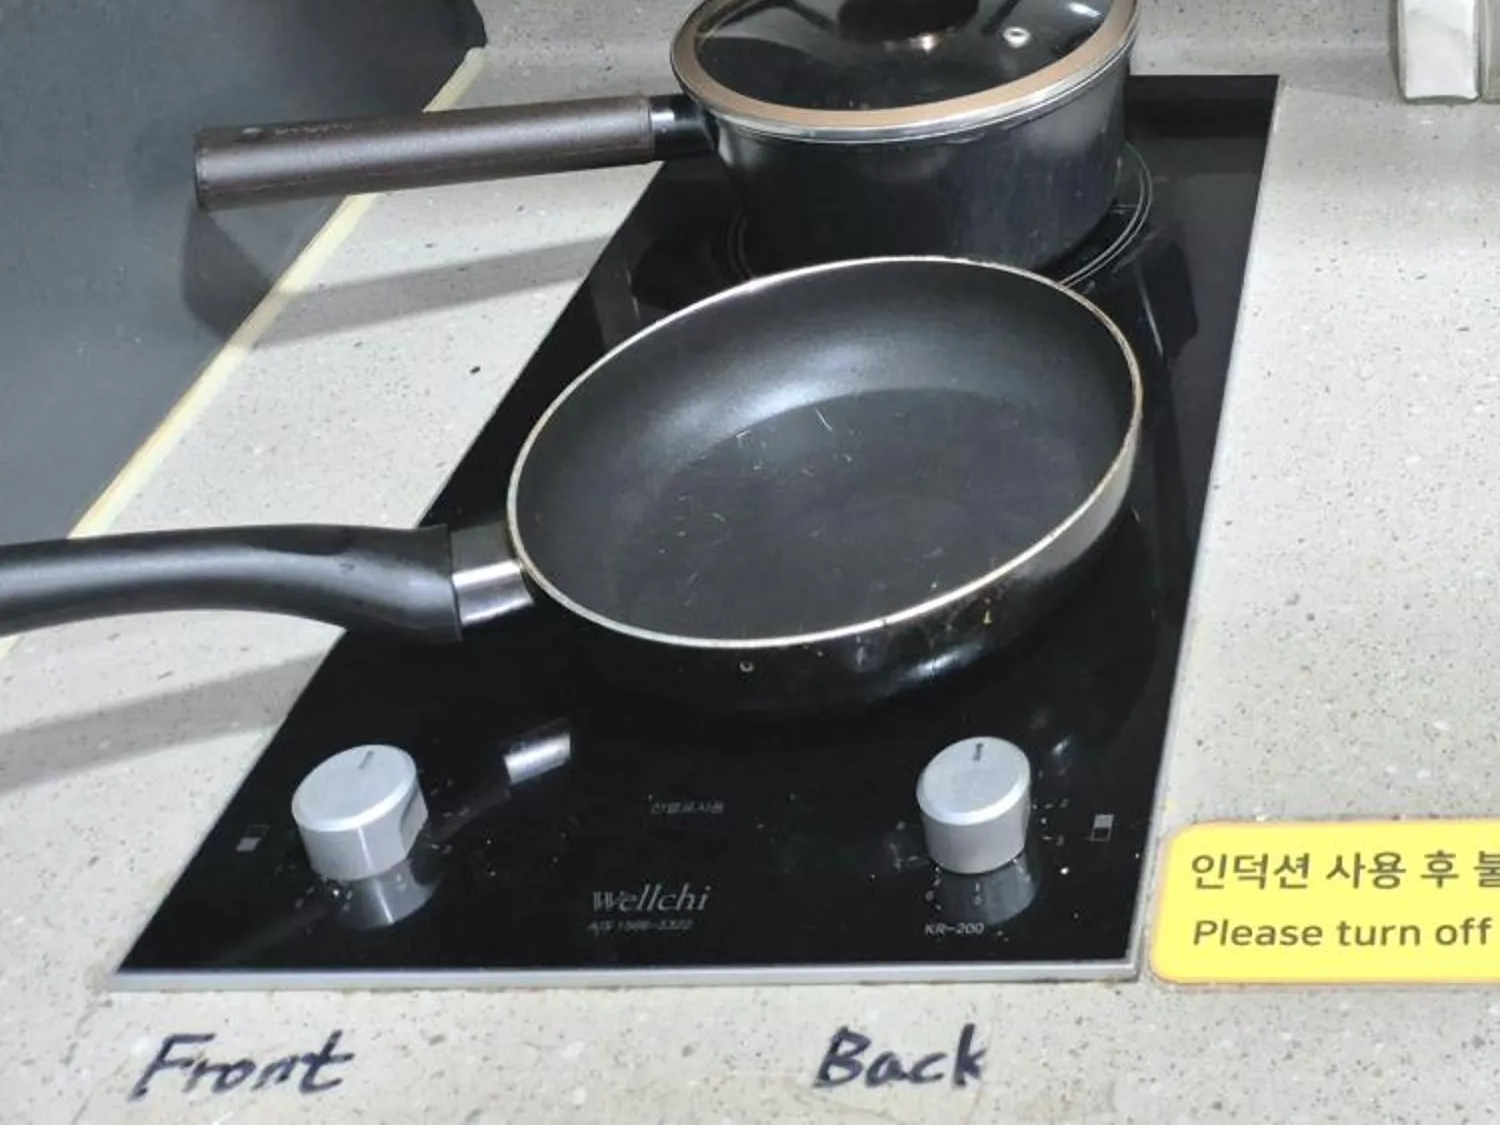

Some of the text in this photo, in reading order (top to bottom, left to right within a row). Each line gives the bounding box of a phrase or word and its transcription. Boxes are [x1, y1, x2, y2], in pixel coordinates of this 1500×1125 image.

[1190, 852, 1310, 891] 인덕션
[1325, 851, 1407, 890] 사용
[1420, 849, 1460, 889] 후
[592, 882, 712, 911] Wellchi
[1192, 918, 1324, 947] Please
[1337, 920, 1422, 947] turn
[1434, 916, 1492, 947] off
[131, 1029, 357, 1100] Front
[812, 1022, 987, 1090] Back
